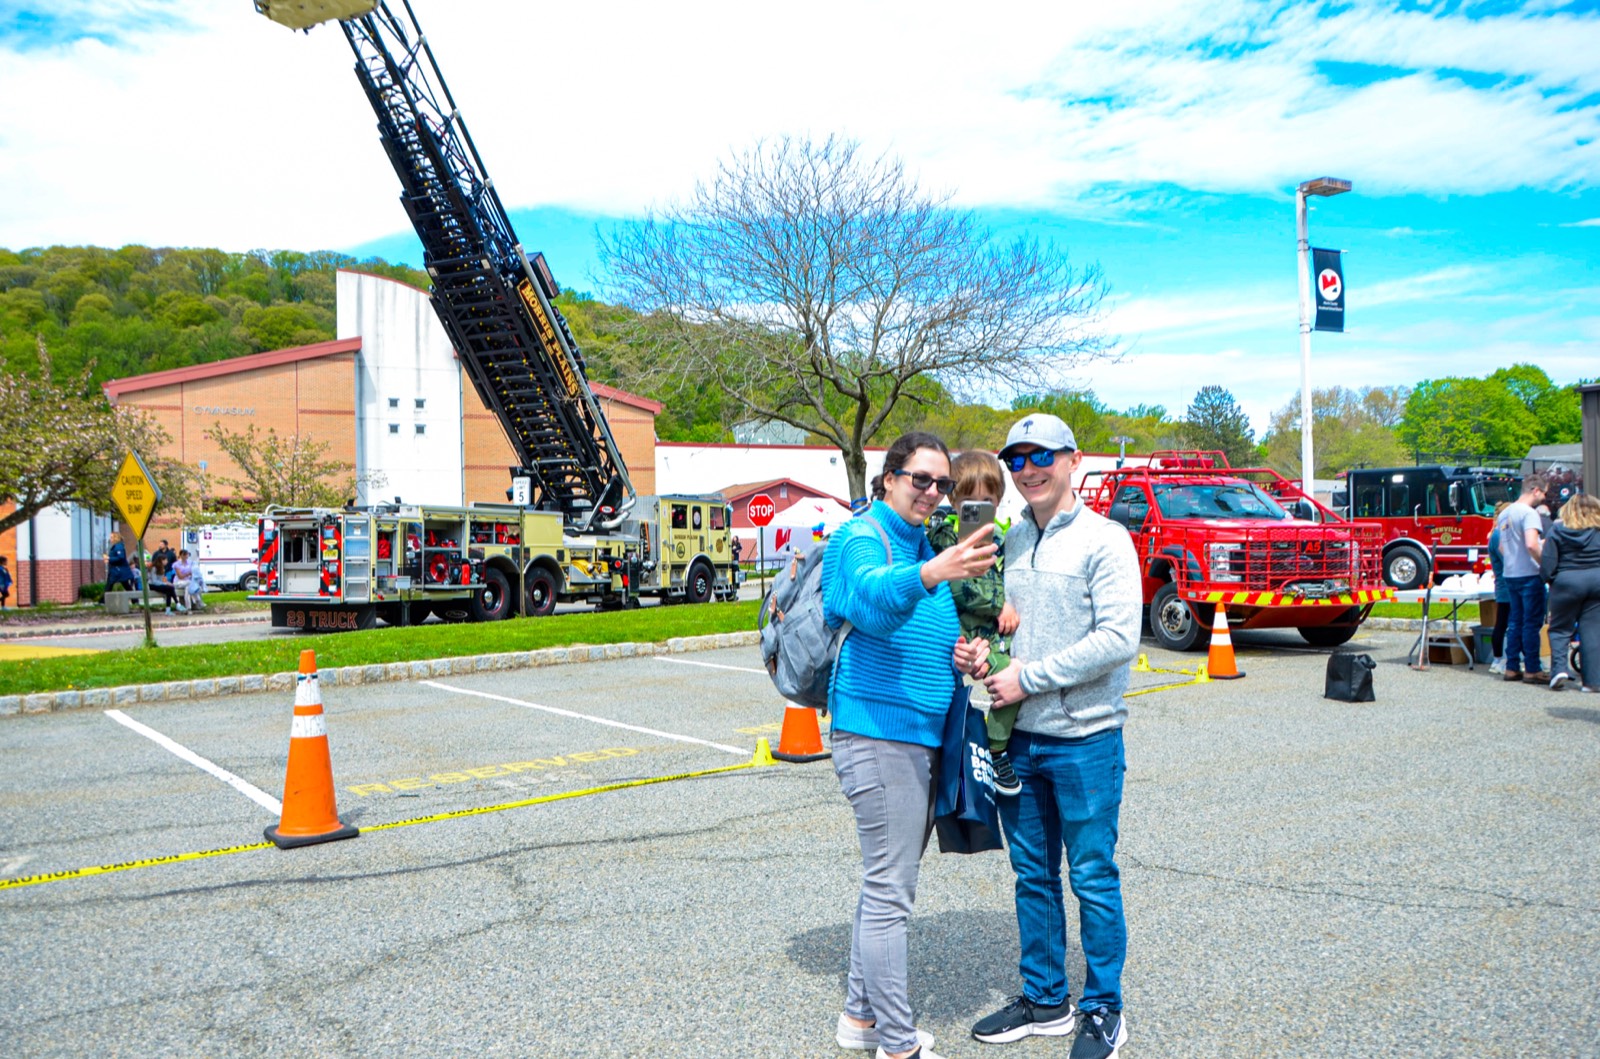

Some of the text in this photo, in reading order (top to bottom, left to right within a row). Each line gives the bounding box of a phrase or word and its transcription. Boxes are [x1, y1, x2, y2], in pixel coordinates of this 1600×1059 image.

[521, 284, 579, 397] MORRIS PLAINS
[192, 405, 256, 416] GYMNASIUM
[121, 475, 145, 486] CAUTION
[125, 490, 143, 500] SPEED
[518, 491, 524, 502] 5
[128, 504, 143, 514] BUMP
[749, 504, 774, 518] STOP
[286, 610, 358, 629] 23 TRUCK
[345, 746, 641, 797] RESERVED
